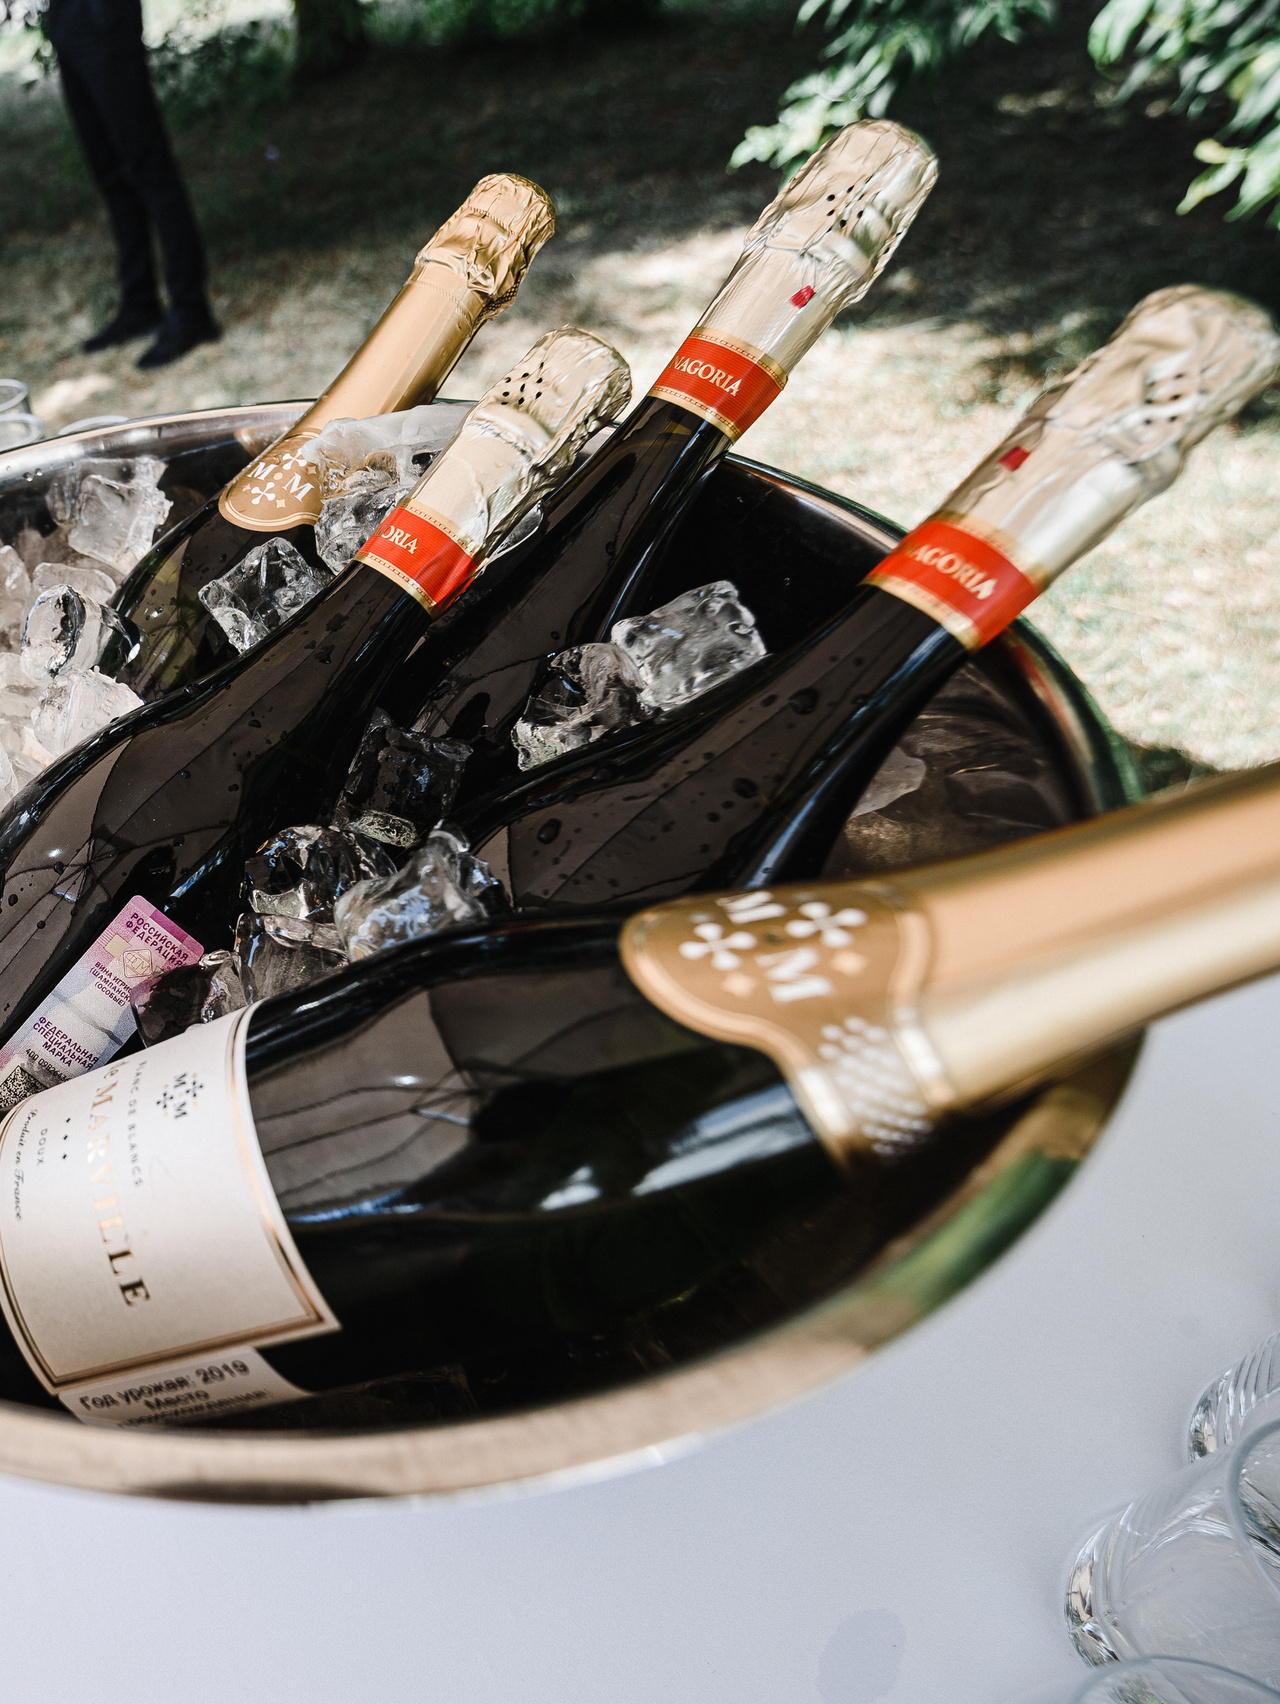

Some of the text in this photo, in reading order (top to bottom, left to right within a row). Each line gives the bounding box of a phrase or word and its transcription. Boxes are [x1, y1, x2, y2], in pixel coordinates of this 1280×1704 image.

[125, 920, 183, 967] ФЕДЕРАЦИЯ
[130, 912, 189, 961] РОССИЙСКАЯ
[94, 961, 113, 979] ВИНА
[94, 981, 126, 1007] (ОСОБЫЕ)
[32, 1022, 95, 1071] СПЕЦИАЛЬНАЯ
[38, 1016, 100, 1064] ФЕДЕРАЛЬНАЯ
[42, 1041, 73, 1068] МАРКА
[87, 1080, 151, 1307] MARVILLE
[78, 1393, 120, 1412] Год
[195, 1358, 250, 1386] 2019
